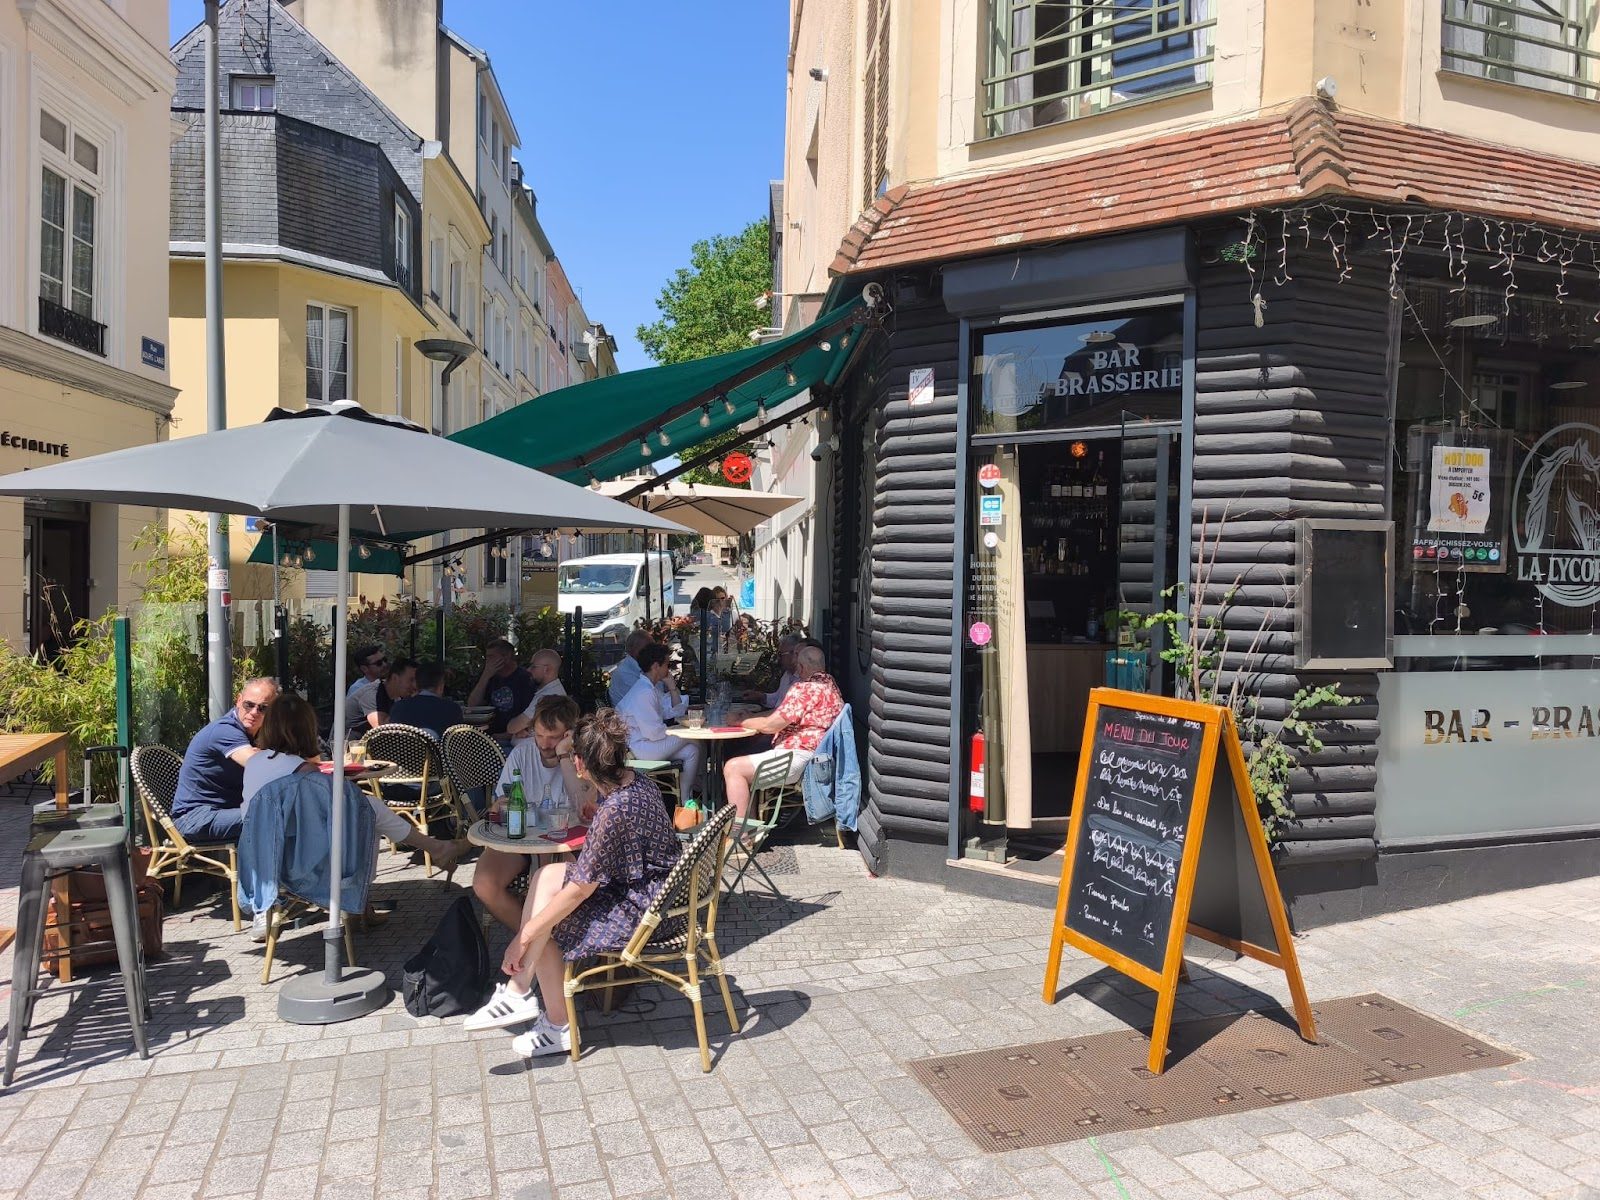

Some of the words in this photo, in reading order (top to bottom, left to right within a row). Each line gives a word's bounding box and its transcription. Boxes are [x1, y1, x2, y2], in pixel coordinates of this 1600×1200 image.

[1093, 344, 1141, 370] BAR
[1054, 367, 1182, 397] BRASSERIE
[1472, 490, 1485, 502] 5€
[1517, 556, 1543, 581] LA
[1103, 723, 1135, 741] MENU
[1139, 728, 1156, 744] DU
[1158, 732, 1189, 751] JOUR
[1423, 709, 1493, 745] BAR
[1503, 720, 1520, 728] -
[1530, 704, 1600, 740] BRA
